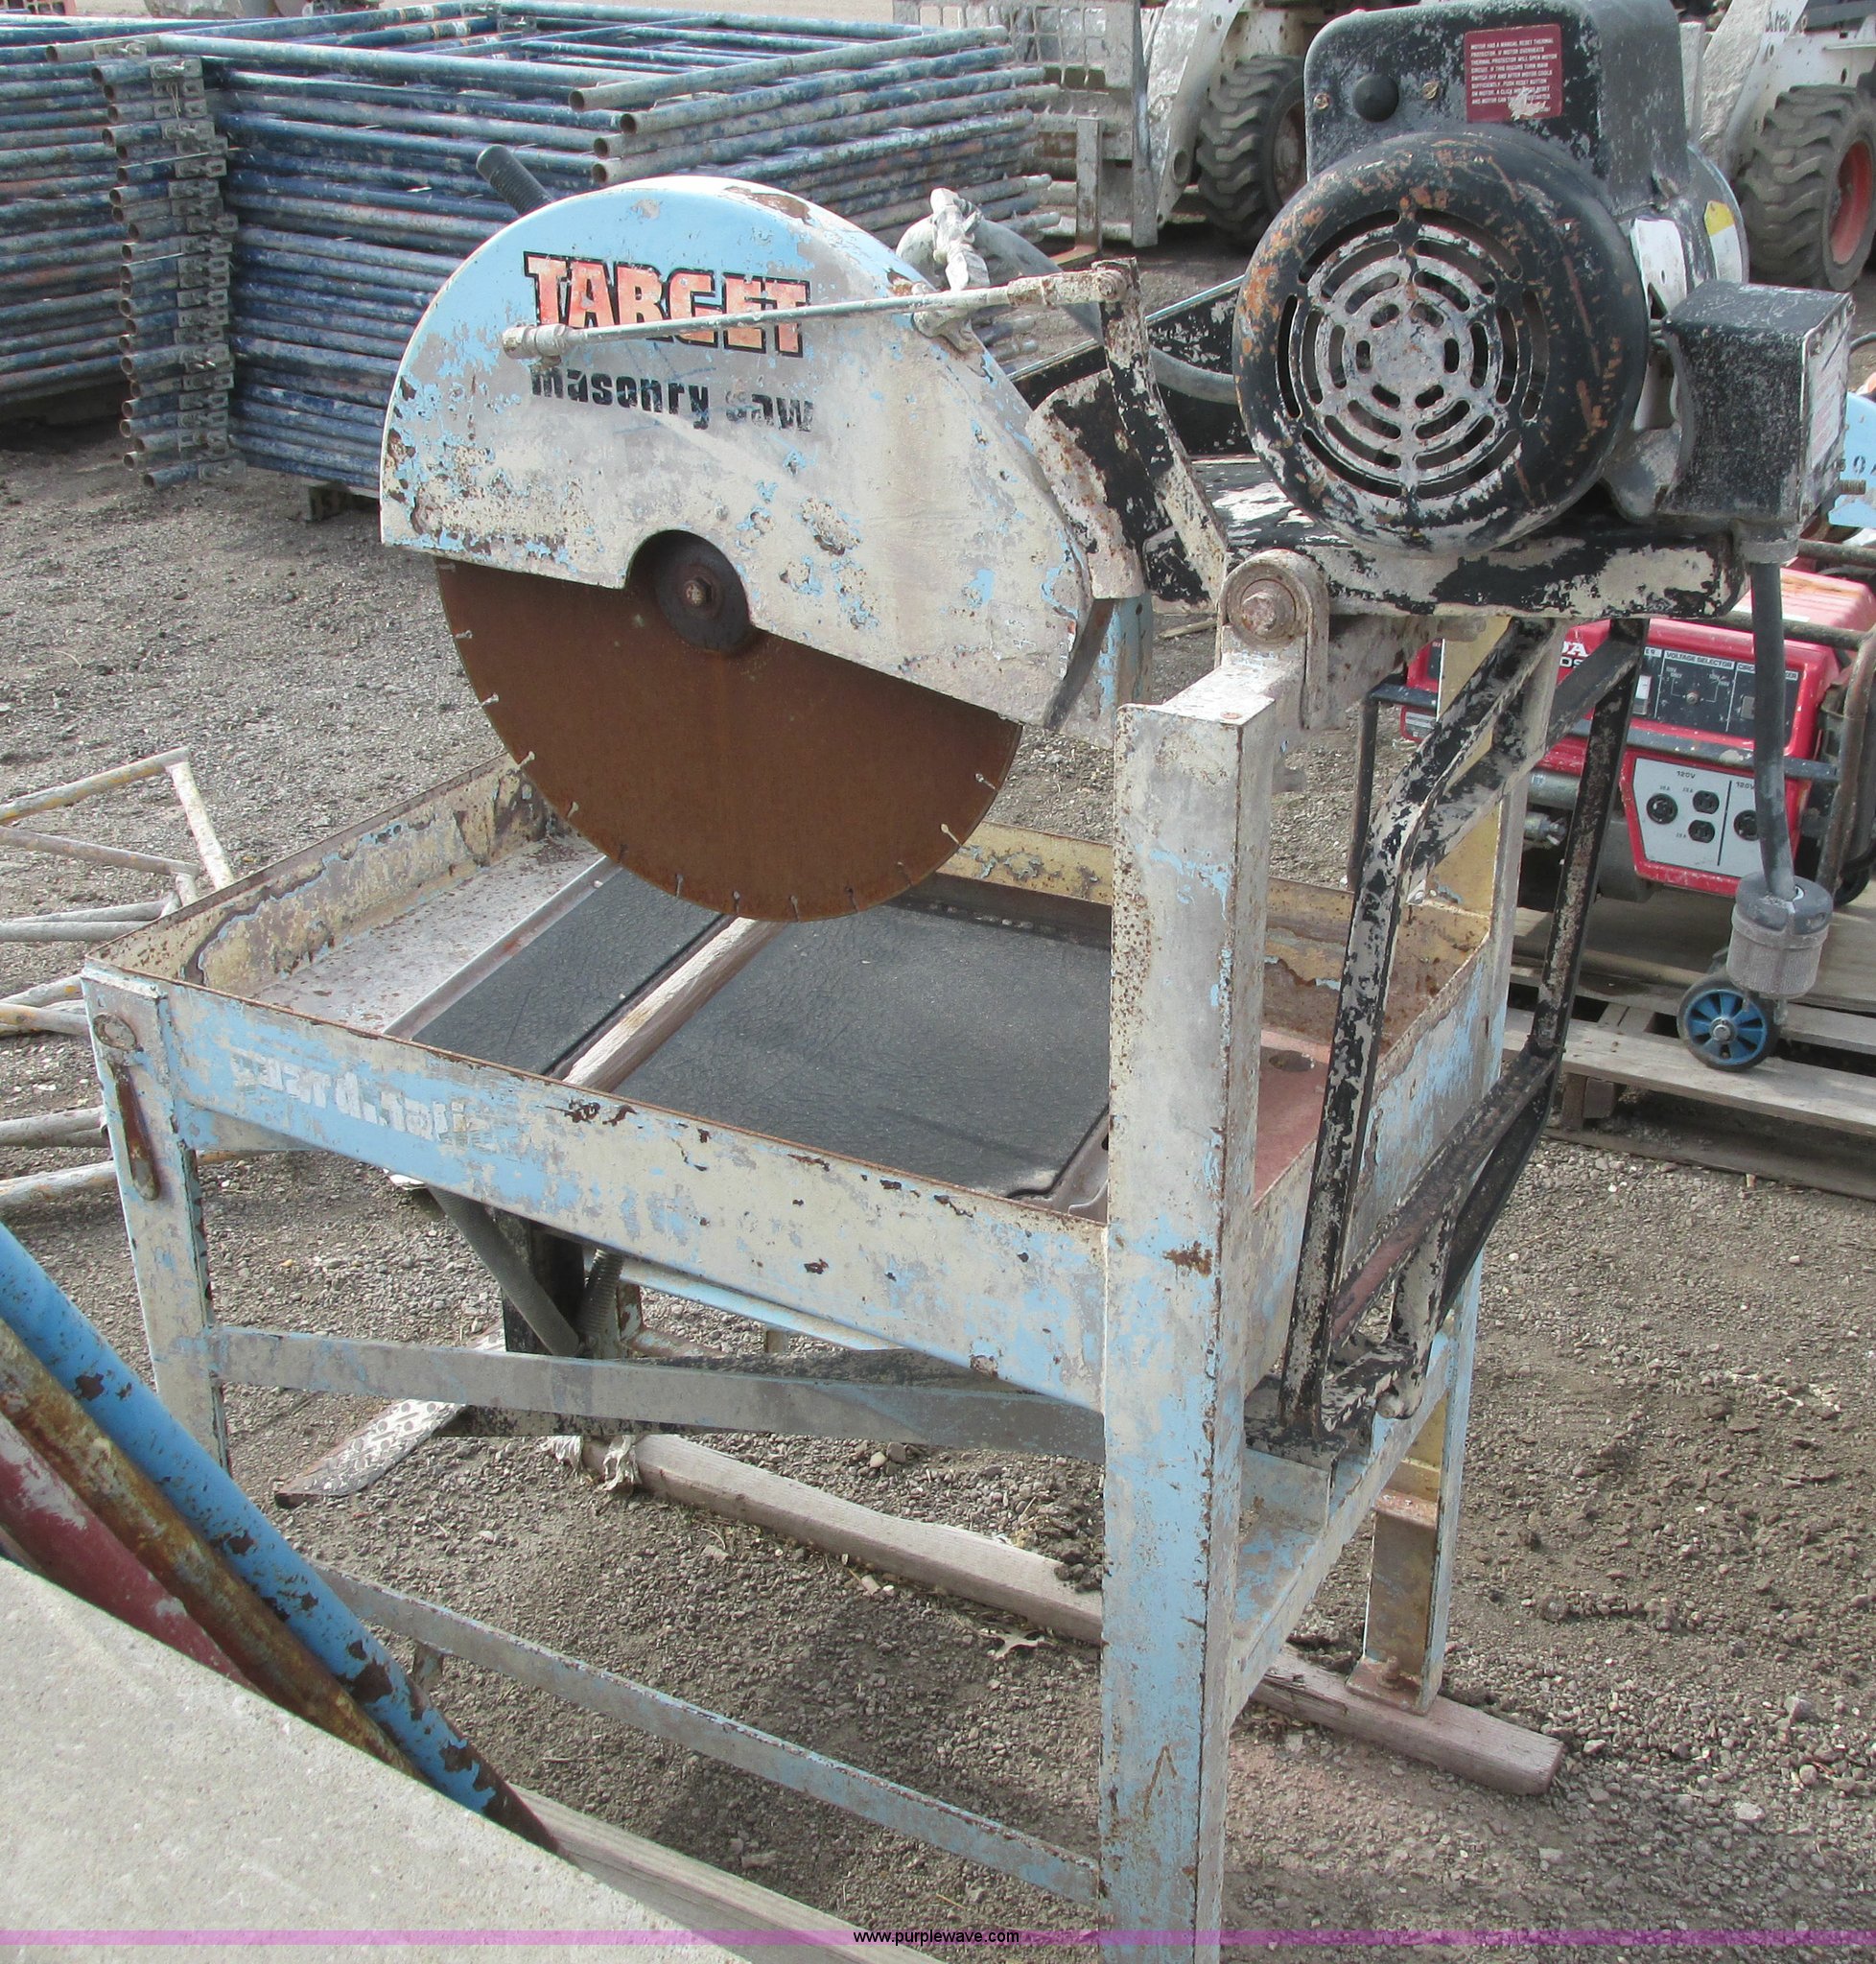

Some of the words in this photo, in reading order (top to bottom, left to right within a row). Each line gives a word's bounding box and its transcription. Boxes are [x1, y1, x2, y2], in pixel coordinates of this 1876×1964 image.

[524, 250, 811, 358] TARGET
[1666, 652, 1696, 663] VOLTAGE
[1697, 656, 1732, 668] SELECTOR
[1677, 770, 1697, 779] 120V
